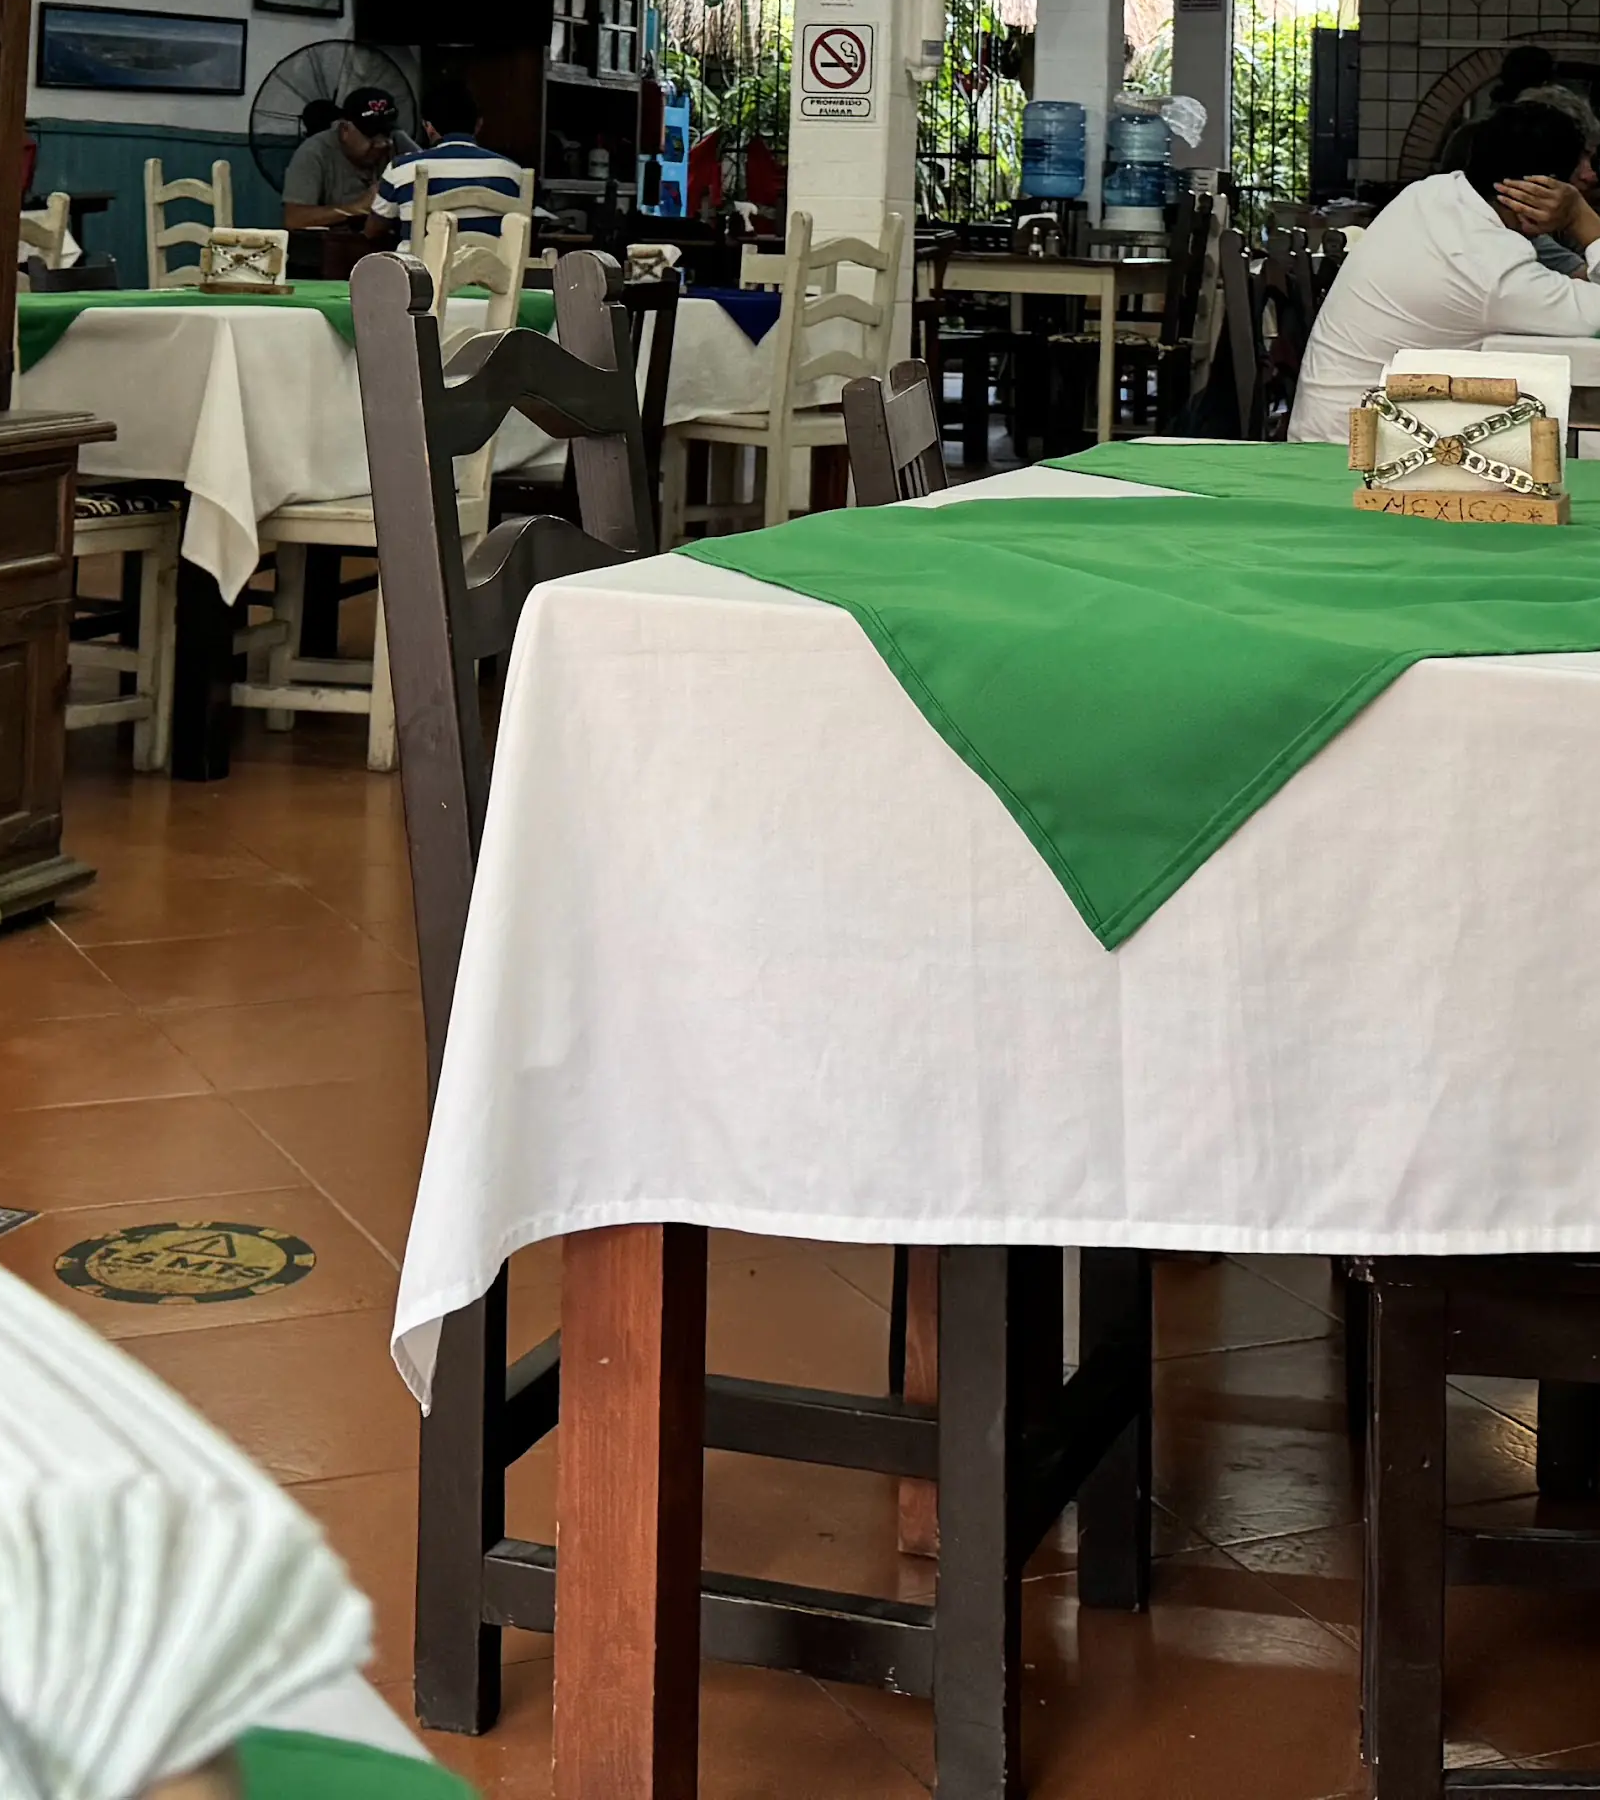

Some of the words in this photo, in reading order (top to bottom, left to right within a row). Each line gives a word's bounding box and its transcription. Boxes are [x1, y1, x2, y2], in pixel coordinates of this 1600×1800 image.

[810, 99, 862, 107] PROHIBIDO
[819, 107, 853, 116] FUMAR
[1382, 495, 1512, 523] MEXICO
[166, 1256, 271, 1279] MTS
